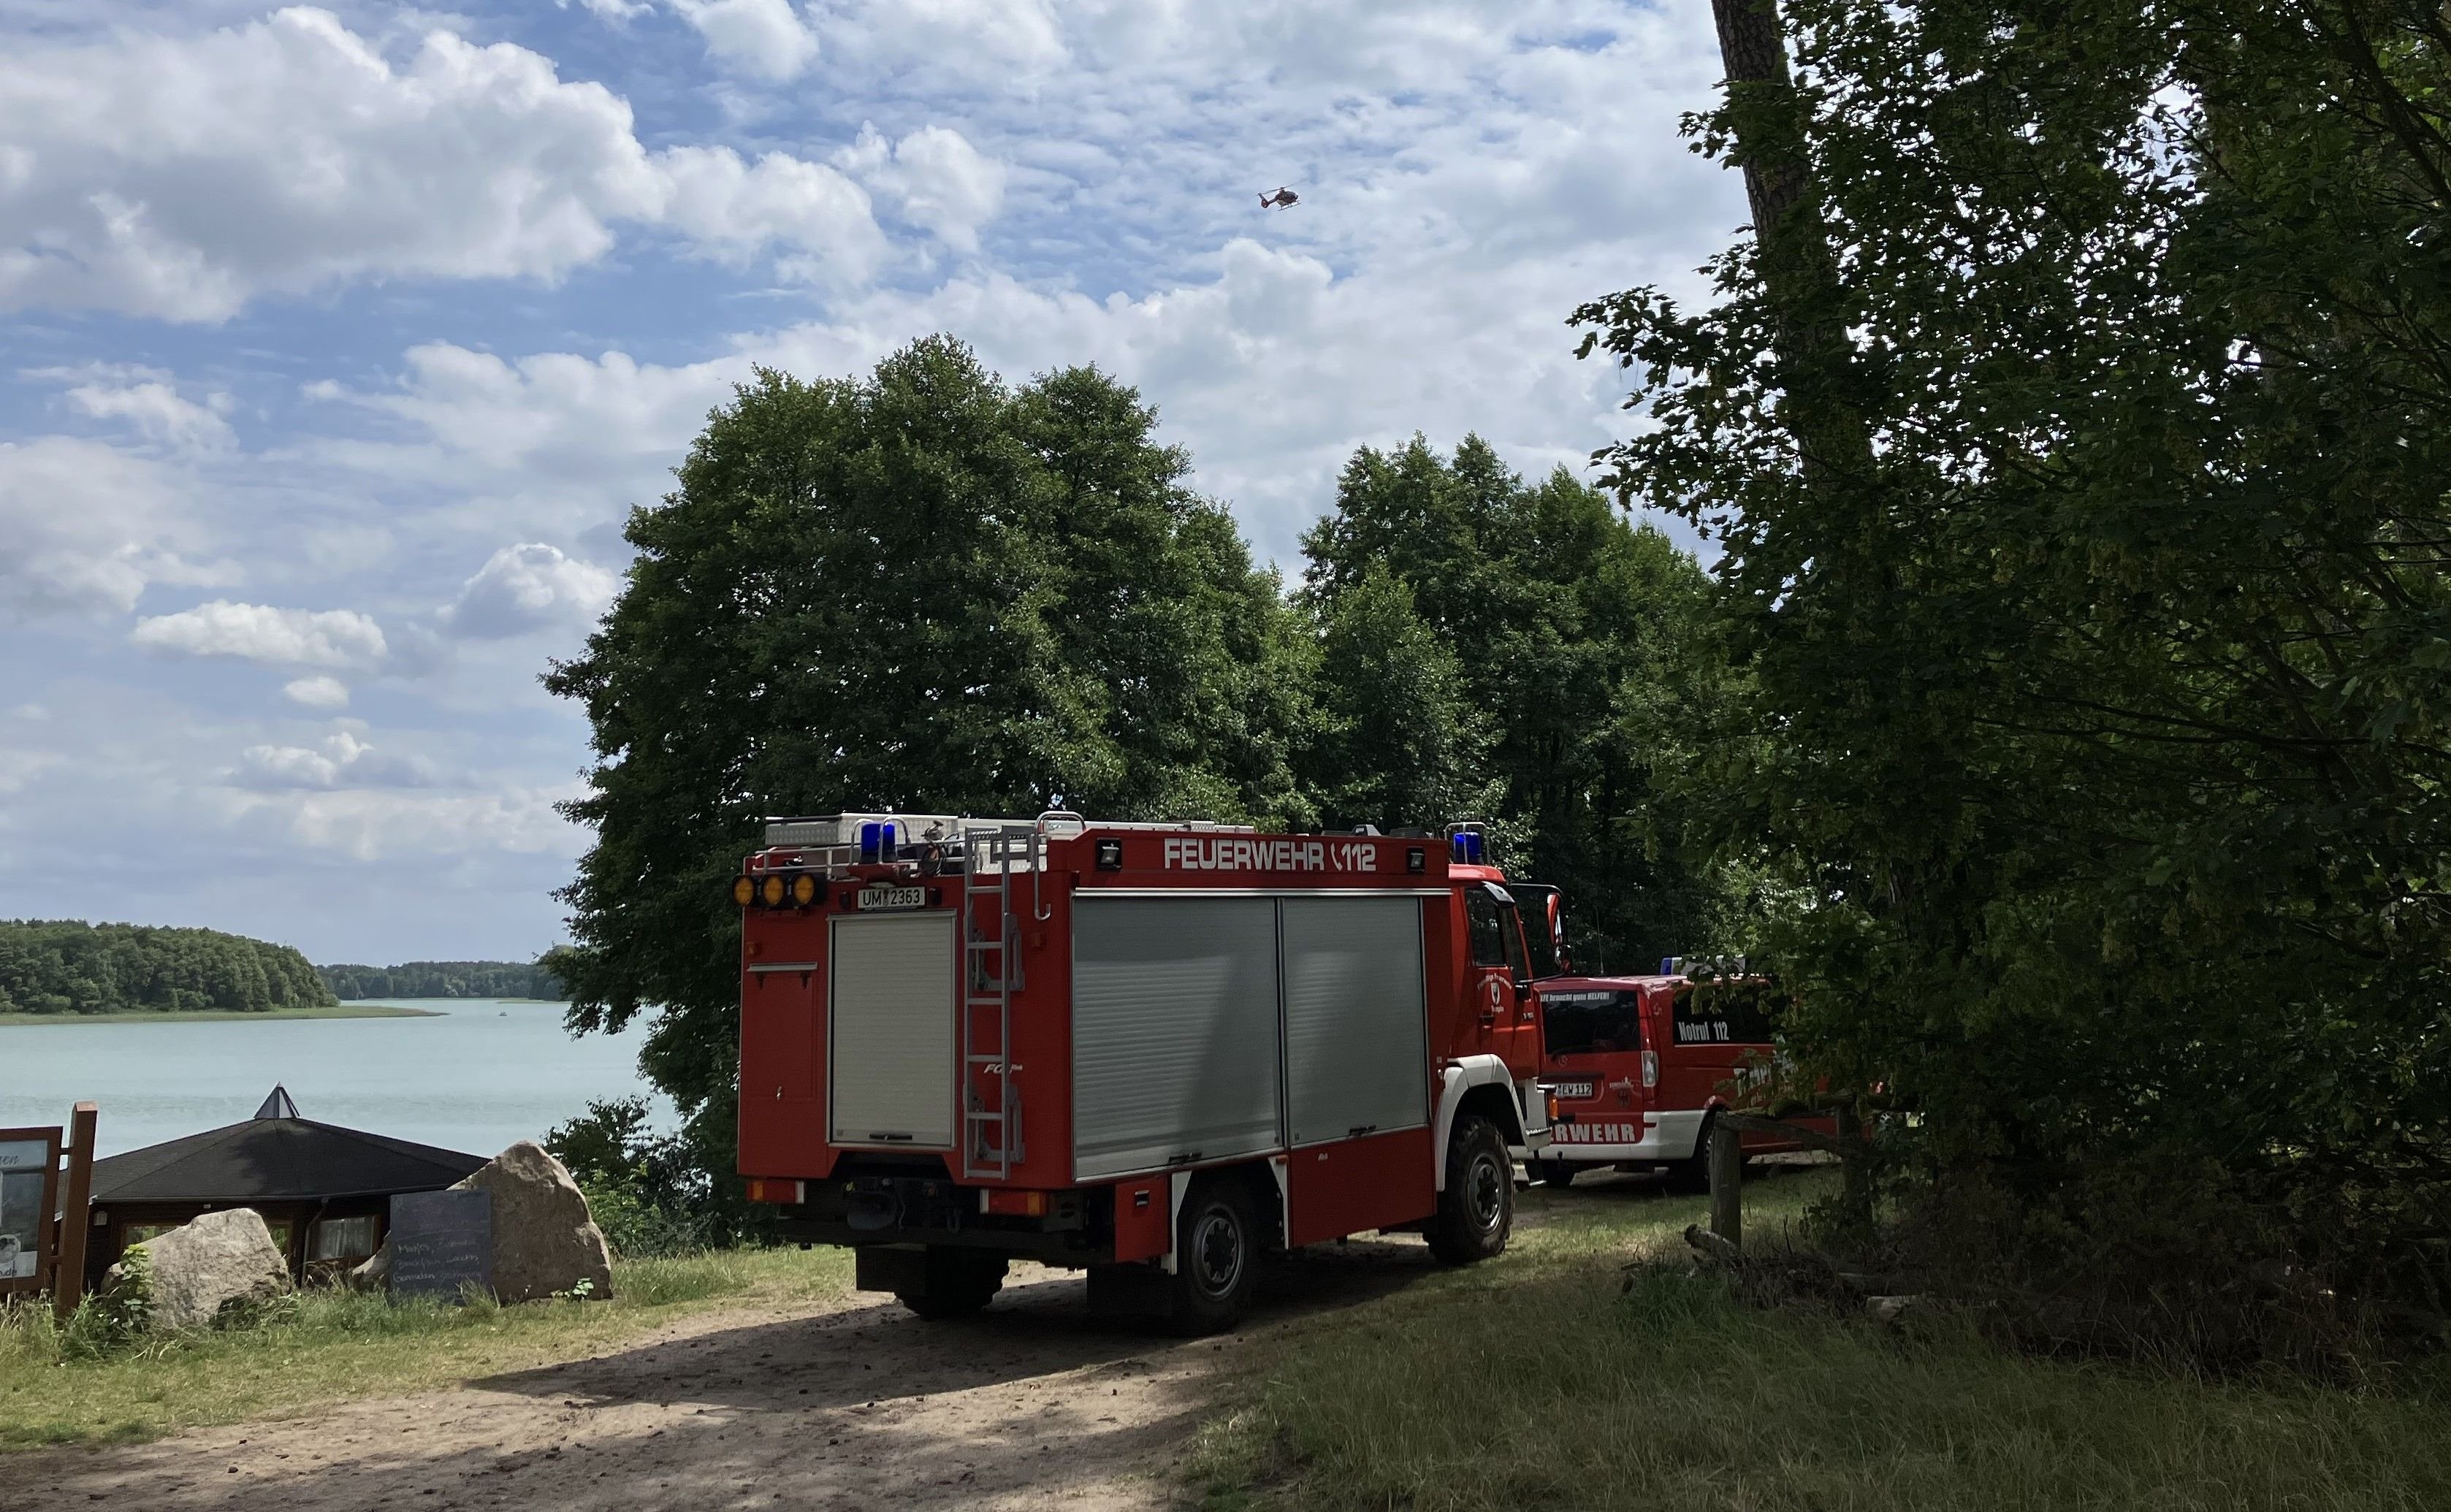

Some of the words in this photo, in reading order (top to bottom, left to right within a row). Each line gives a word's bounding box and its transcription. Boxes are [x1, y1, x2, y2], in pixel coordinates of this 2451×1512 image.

[1164, 838, 1324, 871] FEUERWEHR
[1341, 843, 1376, 871] 112
[863, 890, 882, 906] UM
[891, 889, 920, 905] 2363
[1678, 1021, 1710, 1042] Notruf
[1713, 1021, 1730, 1041] 112
[1576, 1083, 1591, 1095] 112
[1551, 1123, 1636, 1142] RWEHR
